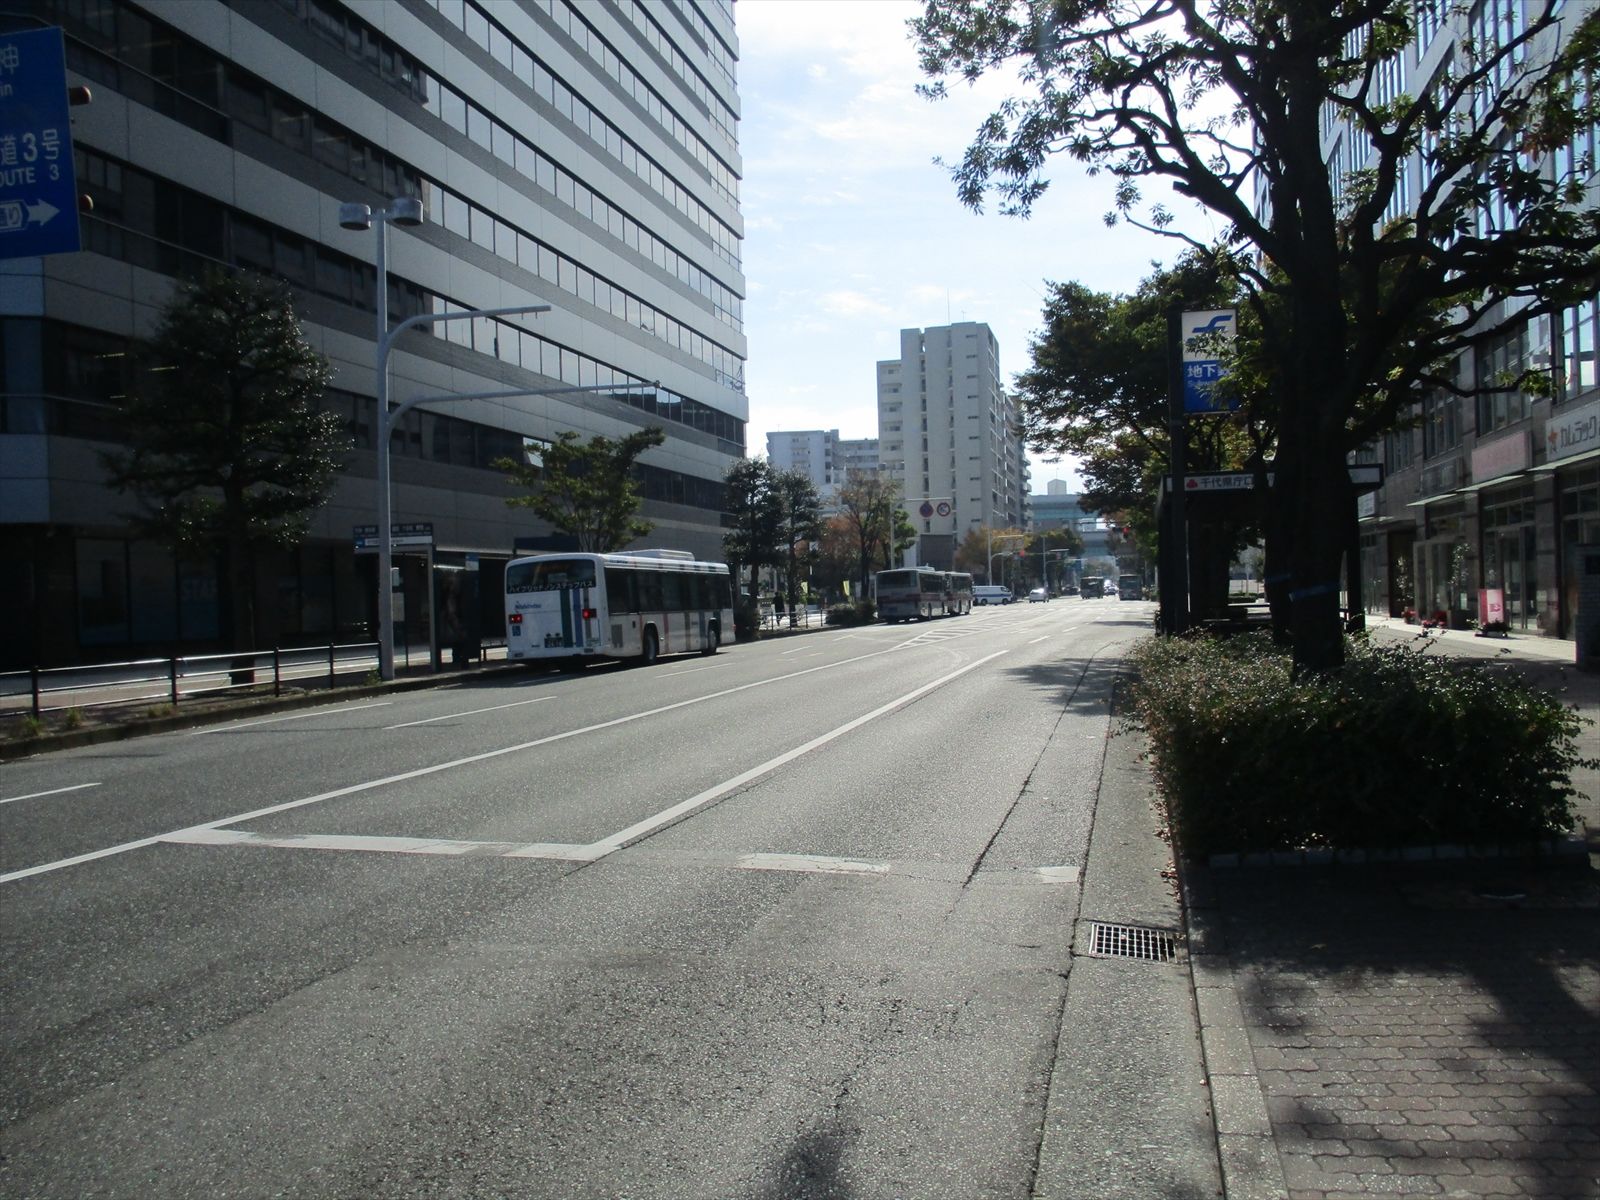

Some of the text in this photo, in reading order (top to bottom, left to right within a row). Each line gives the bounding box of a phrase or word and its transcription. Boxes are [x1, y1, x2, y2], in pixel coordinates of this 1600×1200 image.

[0, 43, 20, 76] 神
[0, 129, 61, 166] 道3号
[49, 164, 60, 181] 3
[1200, 476, 1254, 489] 千代県庁口
